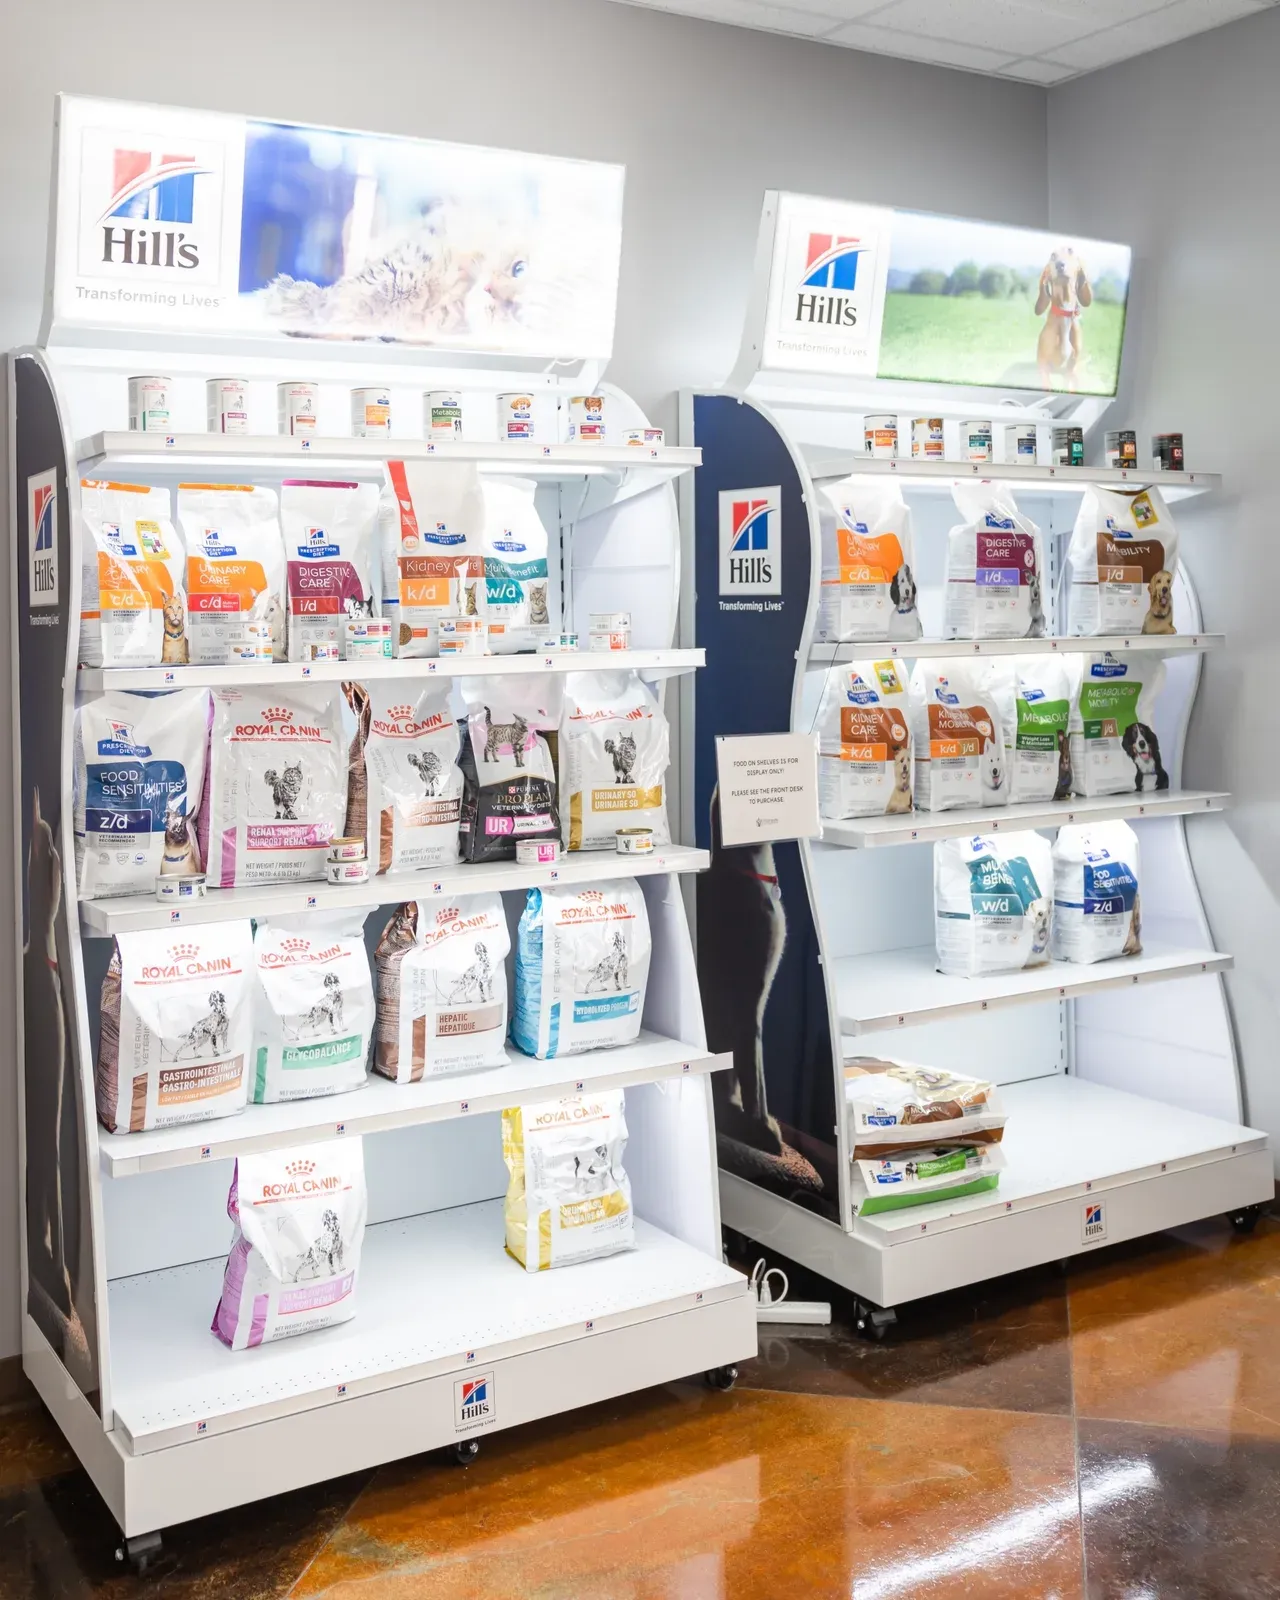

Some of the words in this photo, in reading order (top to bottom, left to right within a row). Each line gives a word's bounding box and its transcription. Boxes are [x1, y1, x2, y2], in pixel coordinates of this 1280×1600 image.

[101, 226, 200, 269] Hill's
[75, 286, 177, 306] Transforming
[182, 293, 220, 307] Lives
[795, 293, 857, 327] Hill's
[776, 339, 841, 356] Transforming
[842, 344, 868, 357] Lives
[985, 548, 1010, 558] CARE
[1106, 543, 1151, 556] MBILITY
[199, 563, 247, 575] URINARY
[405, 560, 451, 574] Kidney
[453, 559, 478, 571] Cre
[485, 563, 539, 577] Multienefit
[729, 557, 772, 584] Hill's
[34, 557, 55, 592] Hill's
[199, 574, 231, 585] CARE
[849, 568, 870, 581] c/d
[985, 571, 1001, 584] i/d
[1106, 569, 1125, 583] j/d
[299, 577, 331, 589] CARE
[406, 585, 436, 601] k/d
[486, 583, 516, 598] w/d
[112, 592, 134, 606] c/d
[199, 595, 222, 609] c/d
[299, 599, 318, 612] i/d
[718, 601, 763, 612] Transforming
[611, 634, 626, 645] DM
[1087, 686, 1129, 698] METABOLIC
[373, 720, 404, 734] ROYAL
[404, 712, 443, 733] CANIN
[850, 712, 884, 724] KIDNEY
[1022, 712, 1068, 725] METABOLIC
[236, 725, 278, 736] ROYAL
[279, 725, 321, 738] CANIN
[850, 725, 879, 736] CARE
[1021, 735, 1040, 743] Weight
[850, 746, 873, 759] k/d
[940, 744, 956, 754] k/d
[962, 743, 975, 754] j/d
[756, 758, 780, 766] SHELVES
[100, 769, 139, 783] FOOD
[746, 768, 768, 776] DISPLAY
[102, 780, 182, 797] SENSITIVITIES
[594, 790, 625, 800] URINARY
[626, 789, 637, 799] SO
[731, 789, 749, 797] PLEASE
[770, 786, 789, 794] FRONT
[496, 794, 523, 805] PRO
[523, 792, 549, 804] PLAN
[594, 800, 628, 810] URINAIRE
[628, 799, 639, 808] SO
[756, 796, 784, 804] PURCHASE
[491, 803, 537, 811] VETERINARY
[536, 801, 552, 809] DIETS
[99, 814, 128, 829] z/d
[488, 818, 509, 833] UR
[250, 827, 276, 836] RENAL
[277, 826, 308, 836] SUPPORT
[250, 837, 283, 847] SUPPORT
[283, 836, 309, 846] RENAL
[538, 846, 554, 856] UR
[255, 862, 275, 870] WEIGHT
[245, 871, 259, 879] PESO
[561, 907, 595, 919] ROYAL
[596, 903, 627, 918] CANIN
[981, 898, 1009, 913] w/d
[1093, 900, 1112, 913] z/d
[425, 927, 448, 945] OYAL
[261, 952, 298, 964] ROYAL
[300, 944, 341, 963] CANIN
[142, 966, 181, 979] ROYAL
[186, 957, 232, 974] CANIN
[553, 934, 561, 1000] VEERINARY
[576, 1004, 611, 1016] HYDROLYZED
[439, 1013, 469, 1022] HEPATIC
[439, 1021, 476, 1033] HÉPATIQUE
[133, 1016, 142, 1069] VETERINA
[286, 1041, 352, 1061] GLYCOBALANCE
[163, 1060, 236, 1082] GASTROINTESTINAL
[162, 1068, 242, 1093] GASTRO-INTESTINALE
[910, 1105, 943, 1115] MOLITY
[536, 1109, 571, 1125] ROYAL
[263, 1181, 300, 1198] ROYAL
[302, 1176, 341, 1193] CANIN
[1085, 1223, 1103, 1236] Hill's
[461, 1402, 490, 1420] Hill's
[455, 1421, 484, 1434] Transforming
